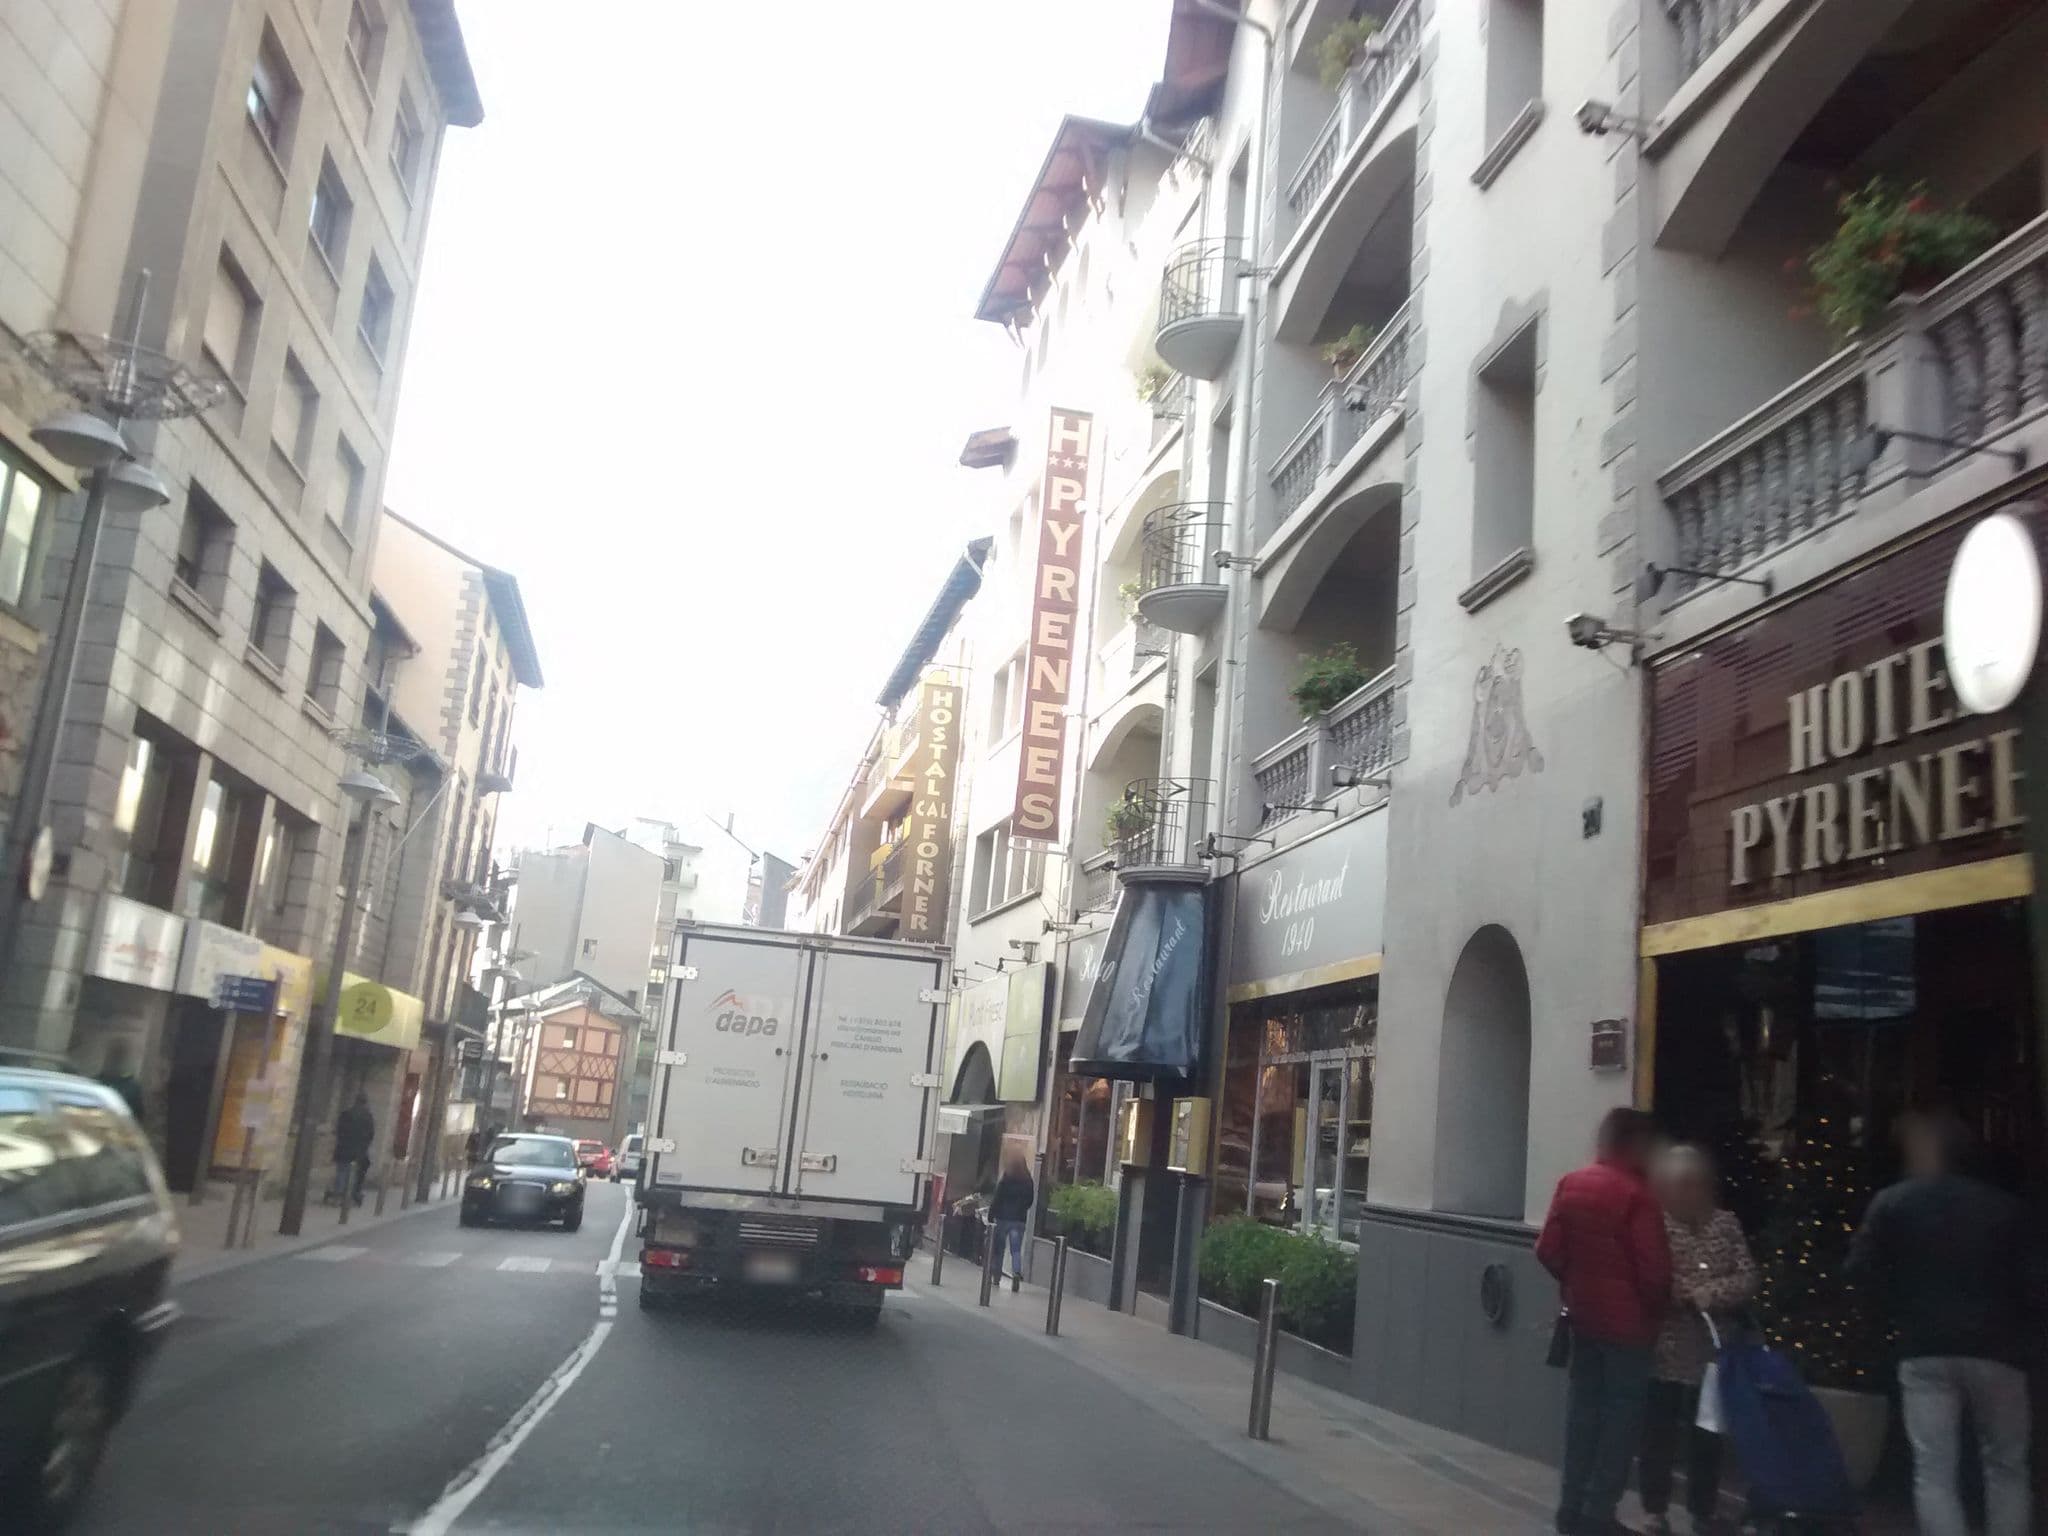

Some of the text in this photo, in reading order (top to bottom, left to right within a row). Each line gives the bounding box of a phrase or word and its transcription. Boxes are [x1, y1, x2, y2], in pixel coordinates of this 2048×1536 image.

[1051, 415, 1088, 457] H
[1018, 475, 1083, 831] PYRENEES
[1787, 634, 1975, 774] HOTE
[924, 689, 953, 797] HOSTAL
[915, 799, 948, 819] CAL
[910, 823, 939, 931] FORNER
[1260, 848, 1351, 924] Restaurant
[1281, 916, 1315, 956] 1940
[354, 997, 377, 1017] 24
[715, 1009, 778, 1037] dapa
